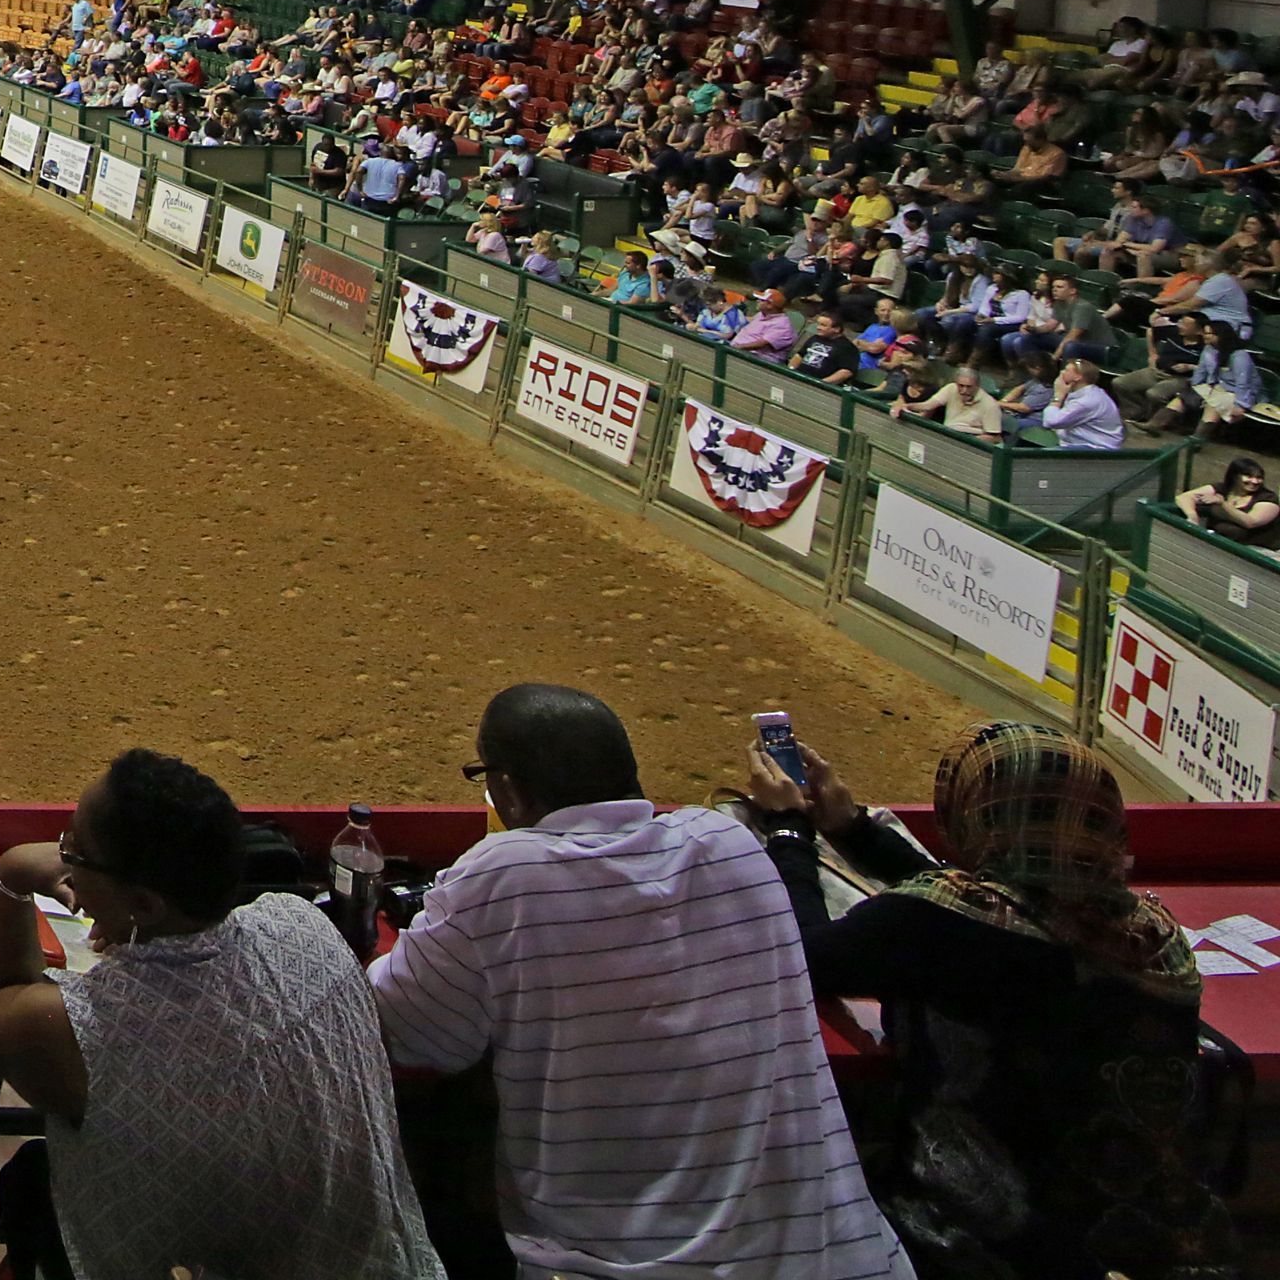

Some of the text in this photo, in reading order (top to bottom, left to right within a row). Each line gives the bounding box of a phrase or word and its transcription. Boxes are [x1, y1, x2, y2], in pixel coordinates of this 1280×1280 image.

[226, 257, 265, 282] JOHN DEERE
[302, 263, 368, 304] STETSON
[310, 286, 336, 302] LEGENDARY
[529, 350, 642, 429] RIOS
[523, 389, 628, 451] INTERIORS
[943, 571, 957, 593] &
[1231, 587, 1246, 603] 35
[915, 578, 990, 628] fort worth
[1196, 694, 1241, 749] Russell
[1169, 706, 1262, 801] Feed & Supply
[1177, 750, 1196, 778] Fort
